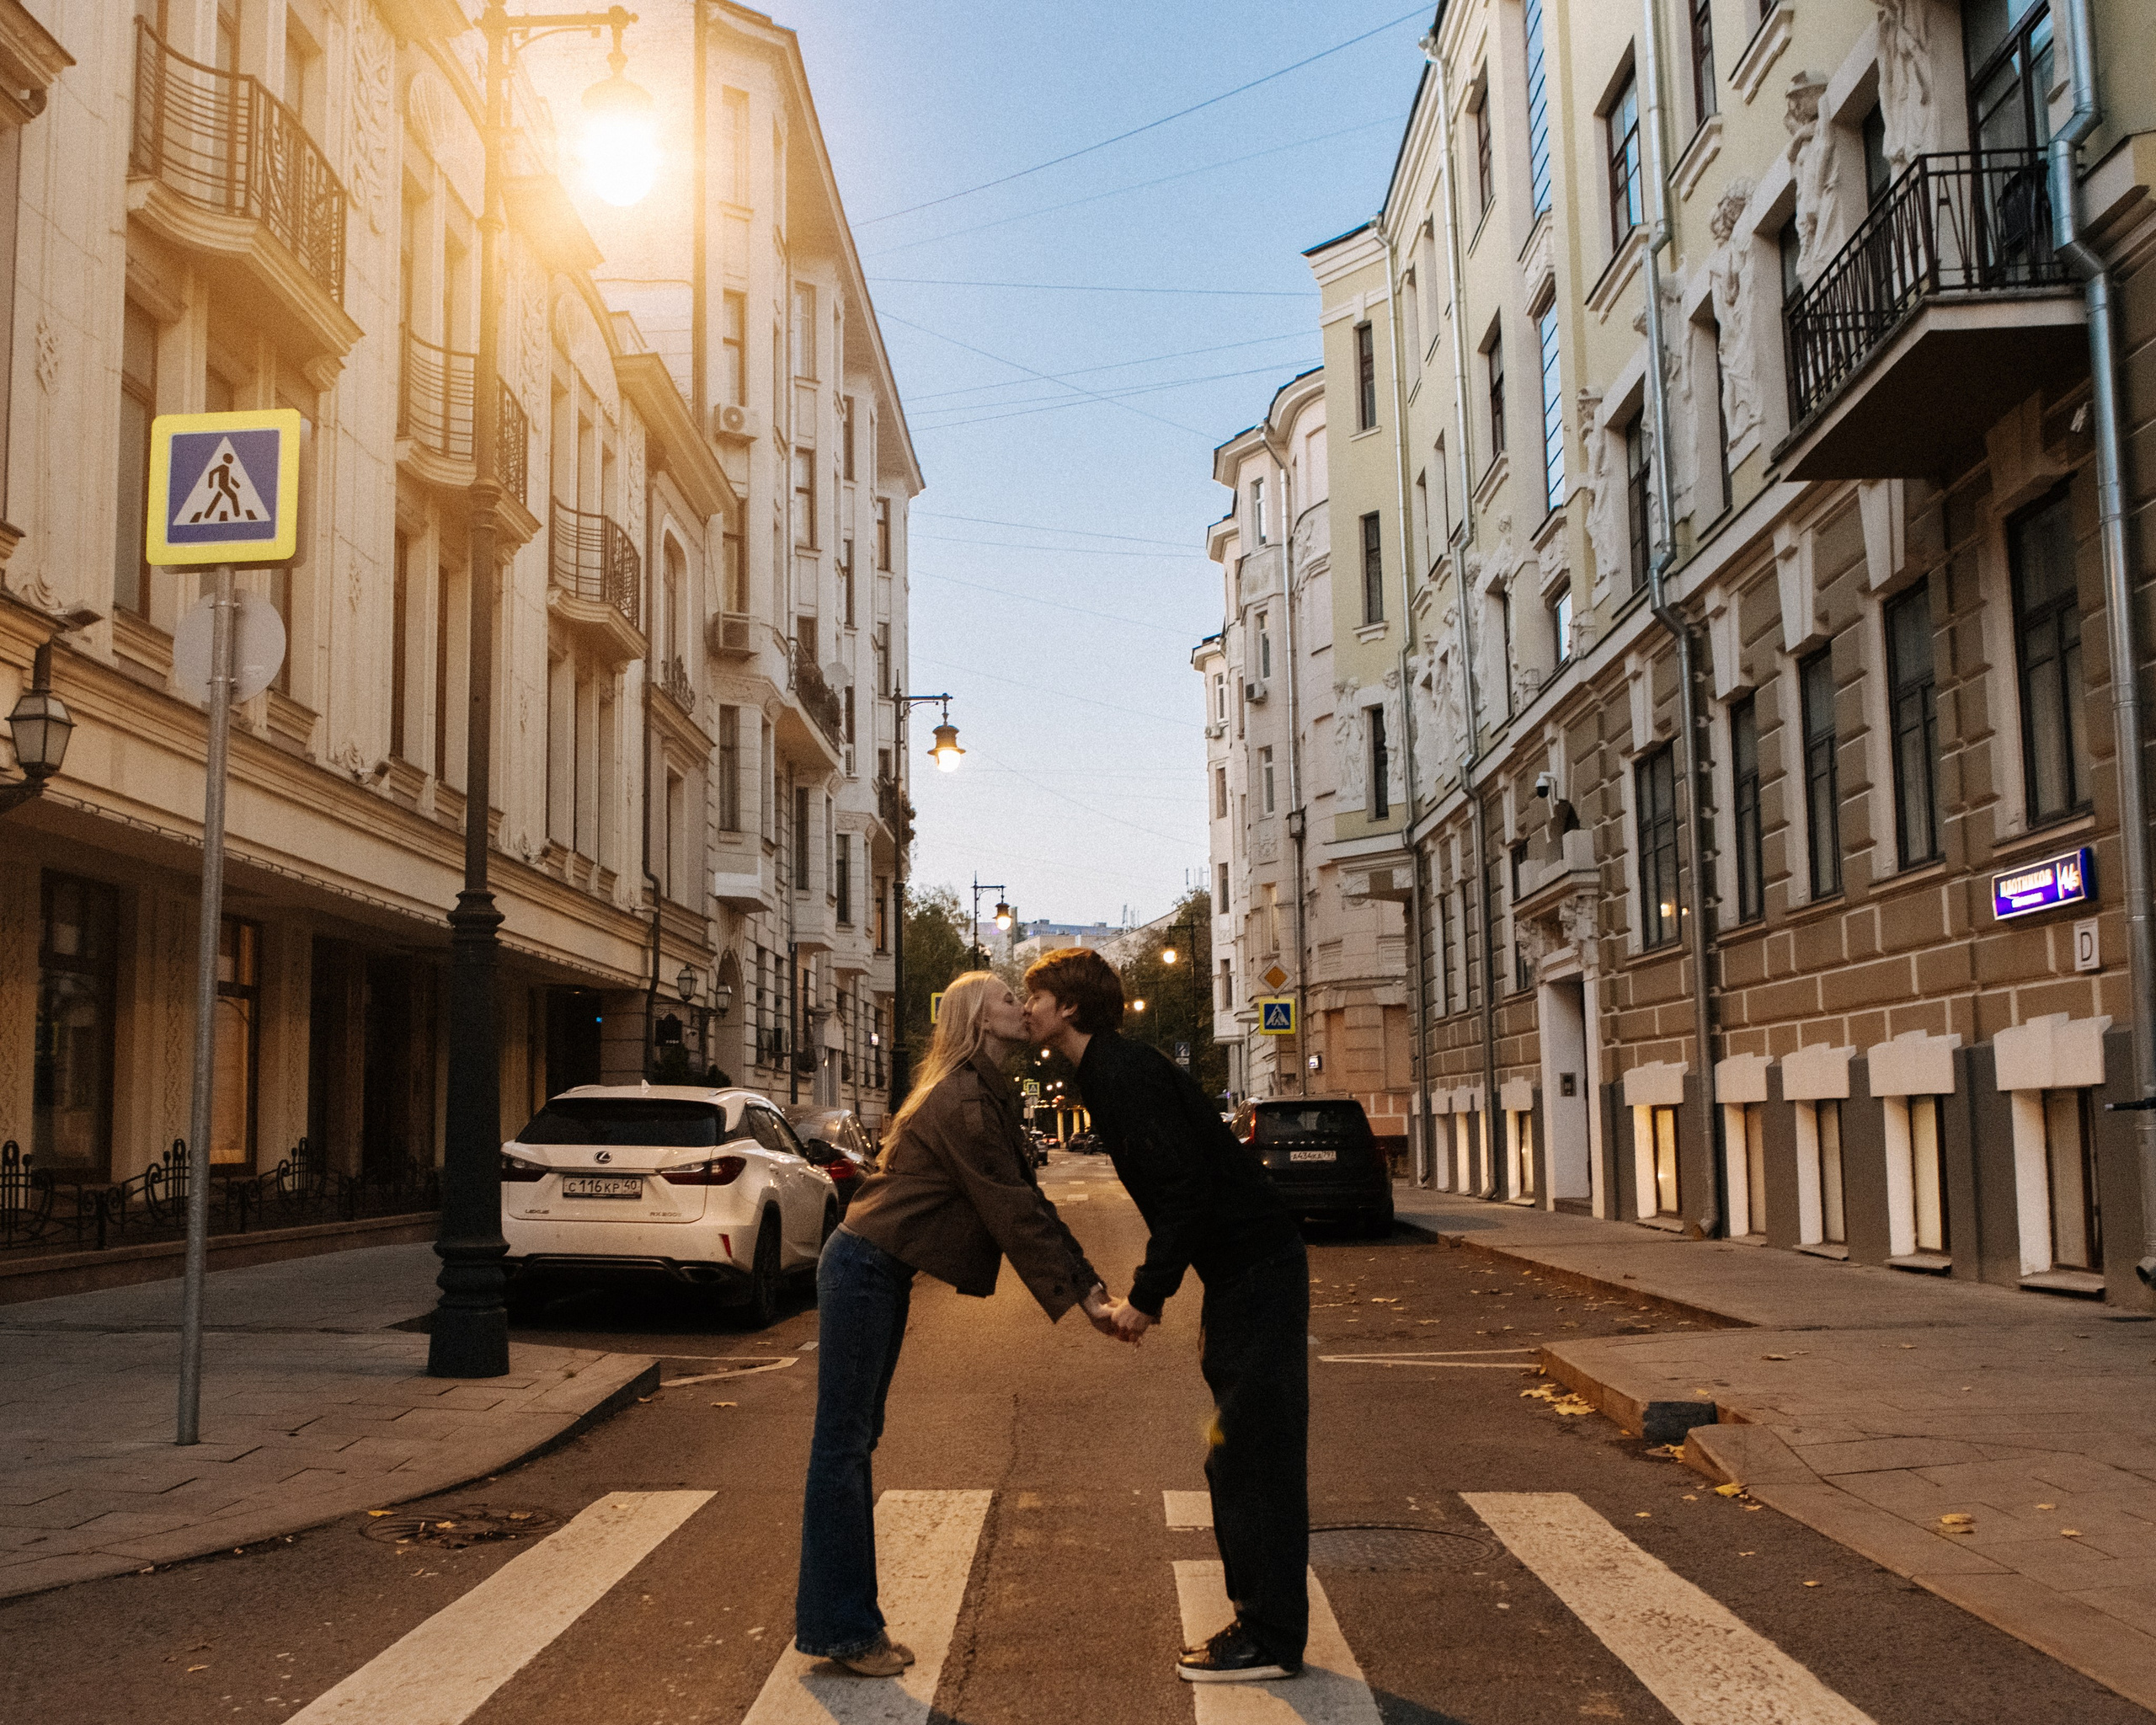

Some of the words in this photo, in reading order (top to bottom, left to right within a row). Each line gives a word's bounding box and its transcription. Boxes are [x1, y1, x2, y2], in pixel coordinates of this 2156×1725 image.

[2000, 868, 2053, 897] ПЛОТНИКОВ
[2080, 932, 2093, 961] D
[624, 1180, 637, 1190] 40
